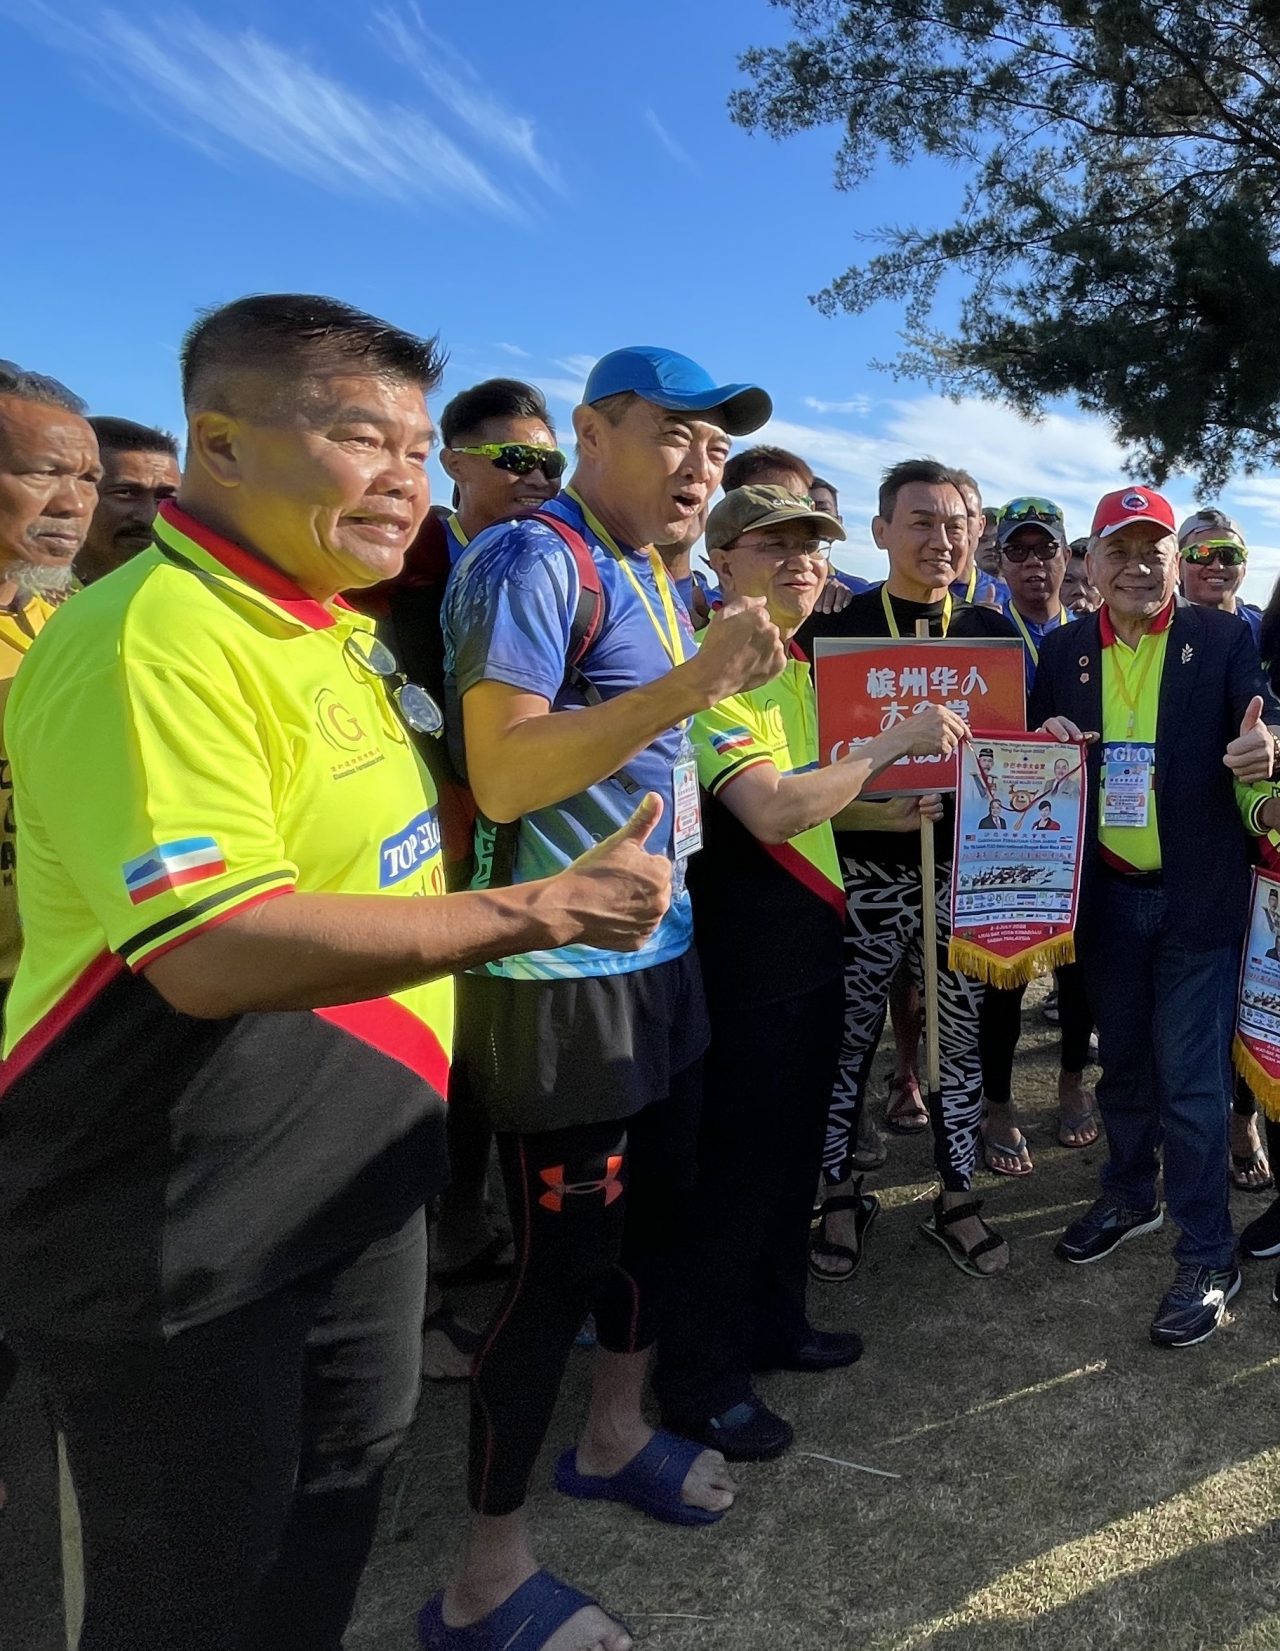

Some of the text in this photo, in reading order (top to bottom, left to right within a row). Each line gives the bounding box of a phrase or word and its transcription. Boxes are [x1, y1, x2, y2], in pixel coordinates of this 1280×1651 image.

[866, 666, 988, 698] 槟州华人
[384, 834, 418, 878] TOP
